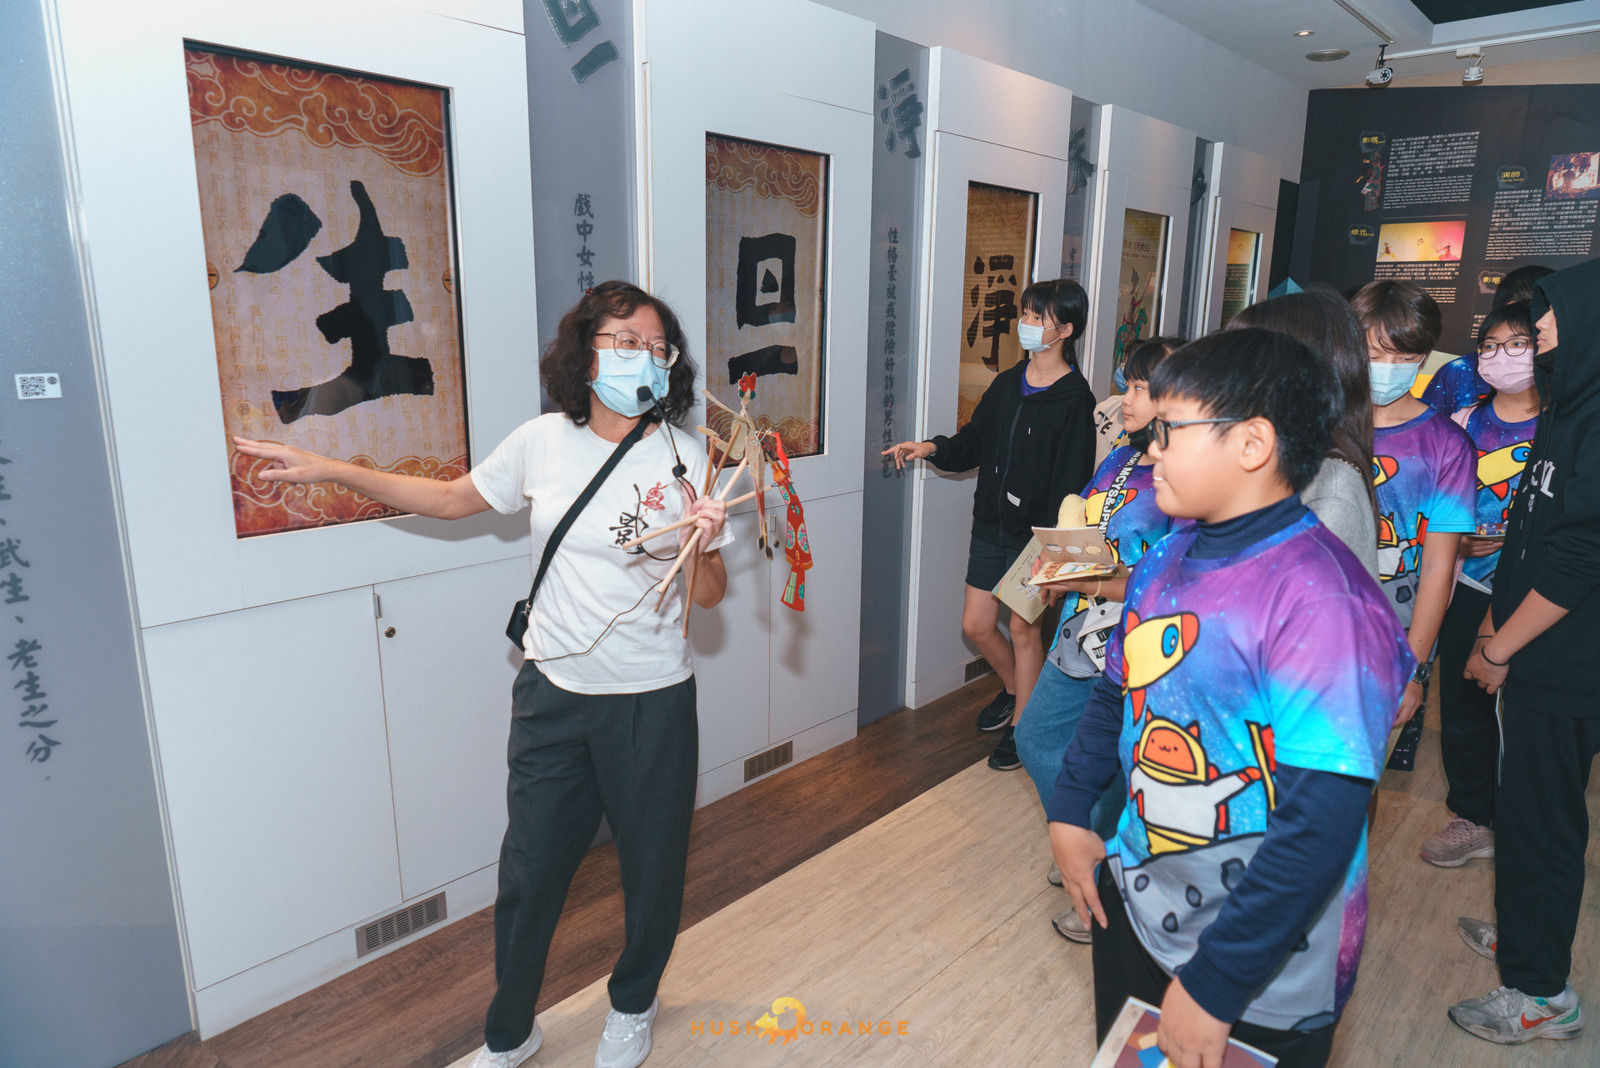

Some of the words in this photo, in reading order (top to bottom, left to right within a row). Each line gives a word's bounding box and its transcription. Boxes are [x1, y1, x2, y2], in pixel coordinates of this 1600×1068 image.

[233, 180, 434, 424] 生
[574, 193, 594, 293] 戲中女性
[728, 232, 799, 385] 旦
